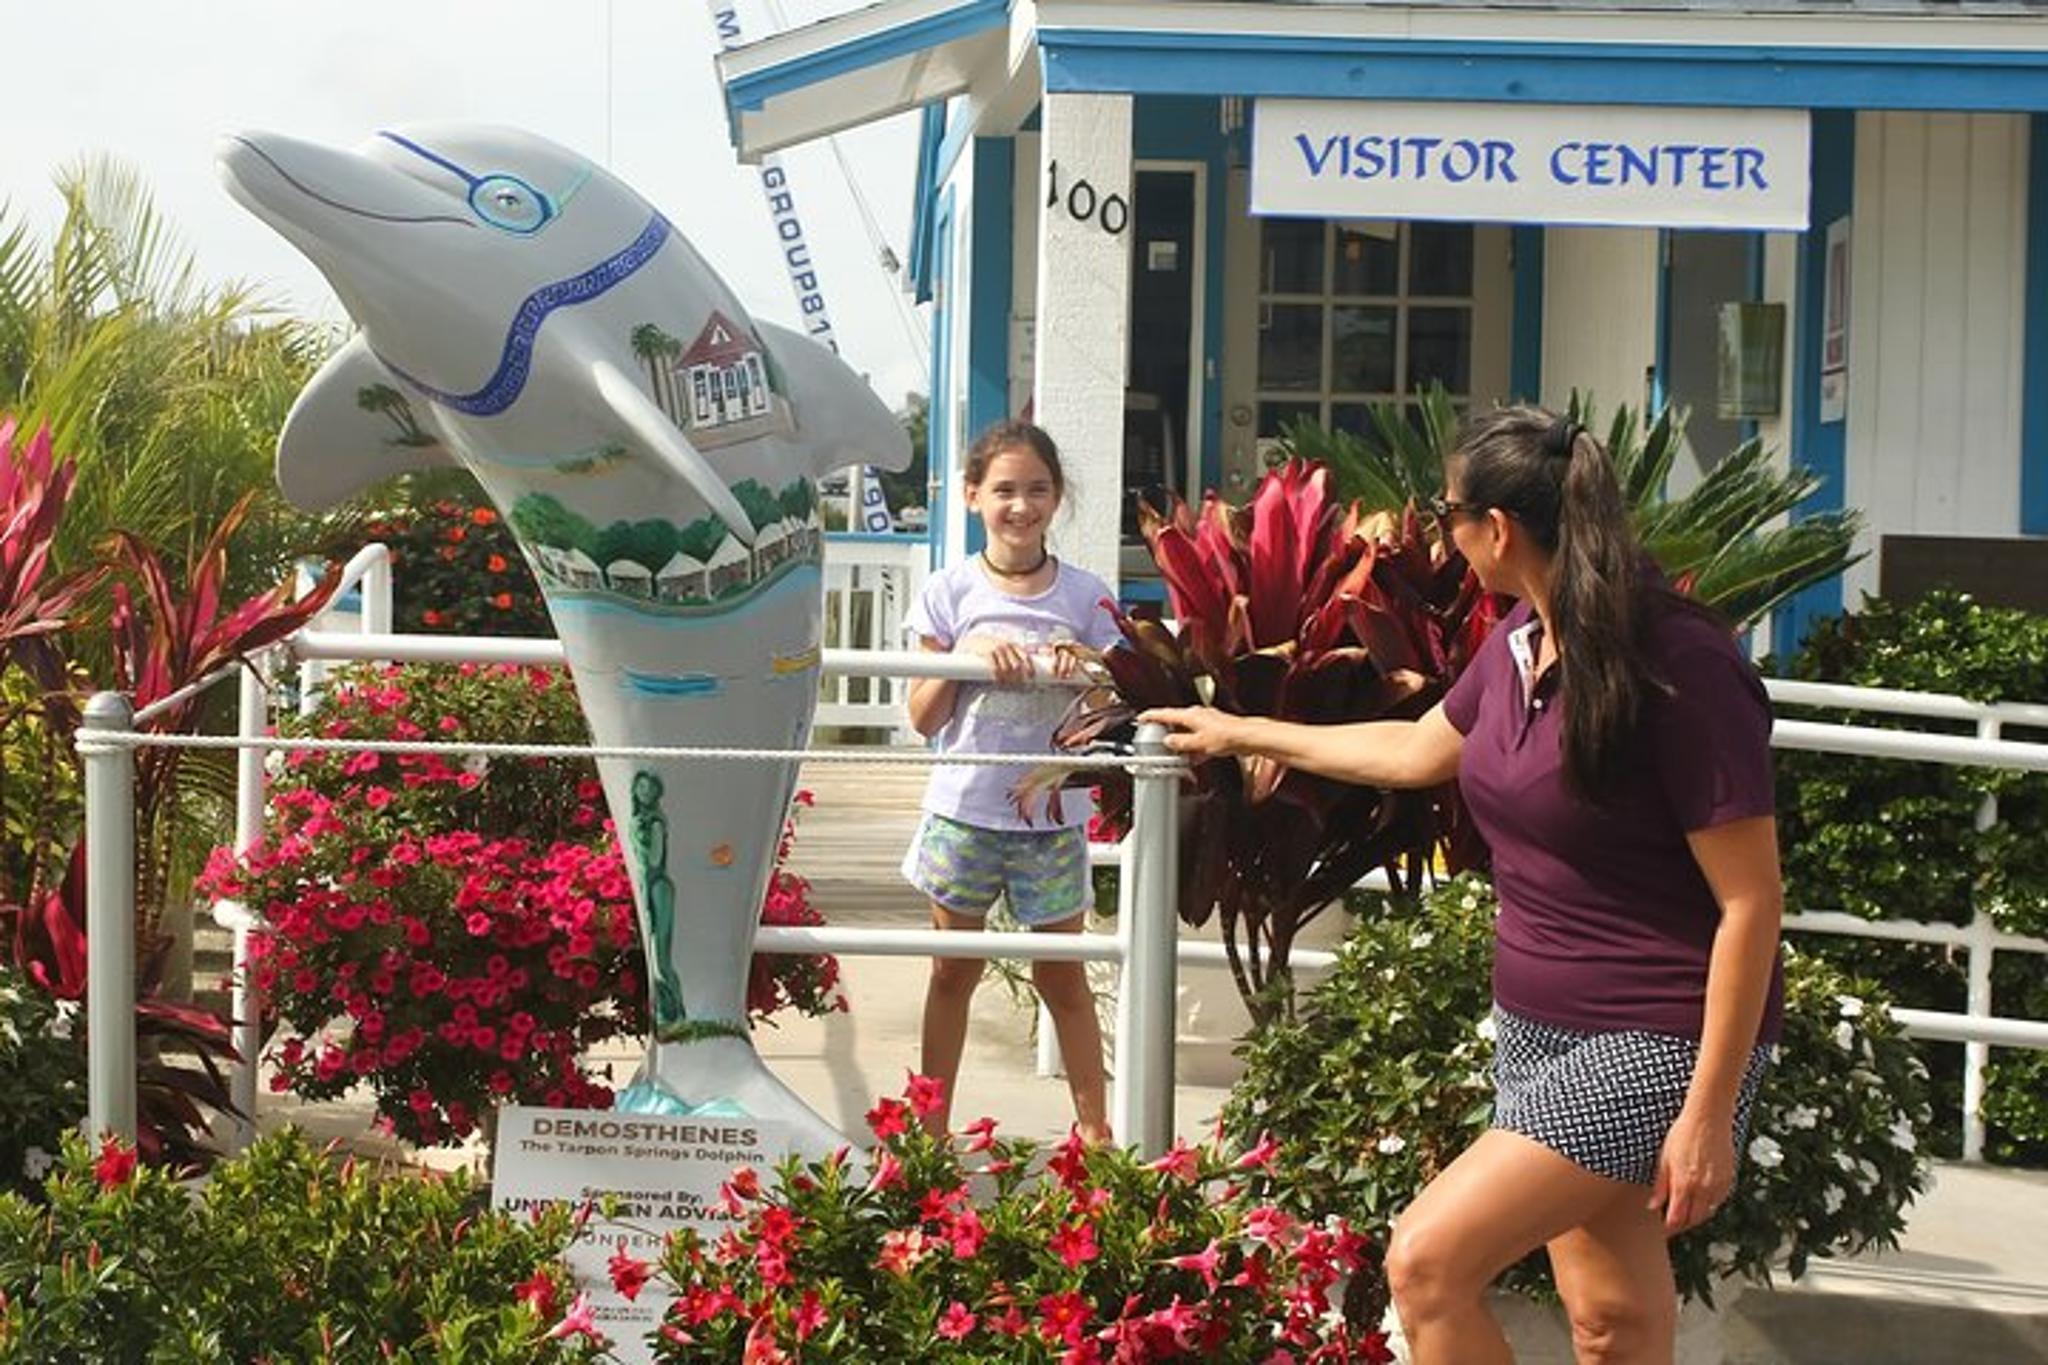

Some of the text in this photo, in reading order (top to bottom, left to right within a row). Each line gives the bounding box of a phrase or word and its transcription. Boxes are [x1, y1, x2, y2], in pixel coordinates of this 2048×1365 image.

[1294, 132, 1768, 190] VISITOR CENTER
[1047, 159, 1127, 234] 100
[520, 1139, 766, 1165] The Tarpon Springs Dolphin
[532, 1118, 759, 1147] DEMOSTHENES
